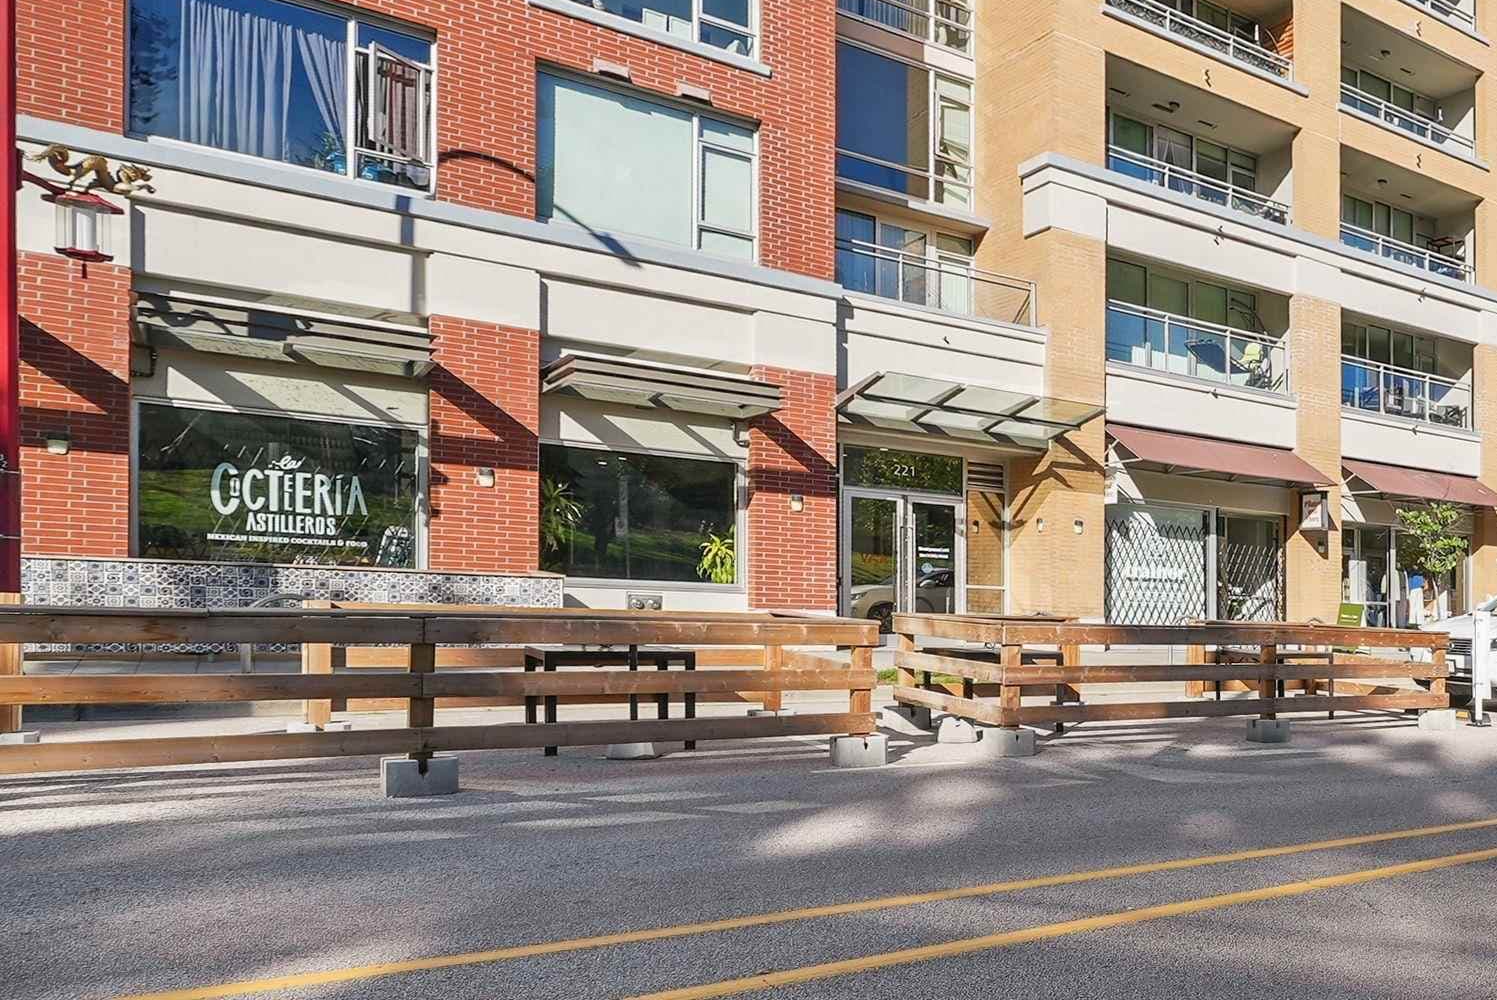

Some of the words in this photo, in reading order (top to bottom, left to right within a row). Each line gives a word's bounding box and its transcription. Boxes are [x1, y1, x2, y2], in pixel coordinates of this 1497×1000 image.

[894, 464, 915, 476] 221
[246, 512, 337, 536] ASTILLEROS
[207, 533, 248, 542] MEXICAN
[291, 537, 337, 546] COCKTAILS
[345, 540, 368, 548] FOOD
